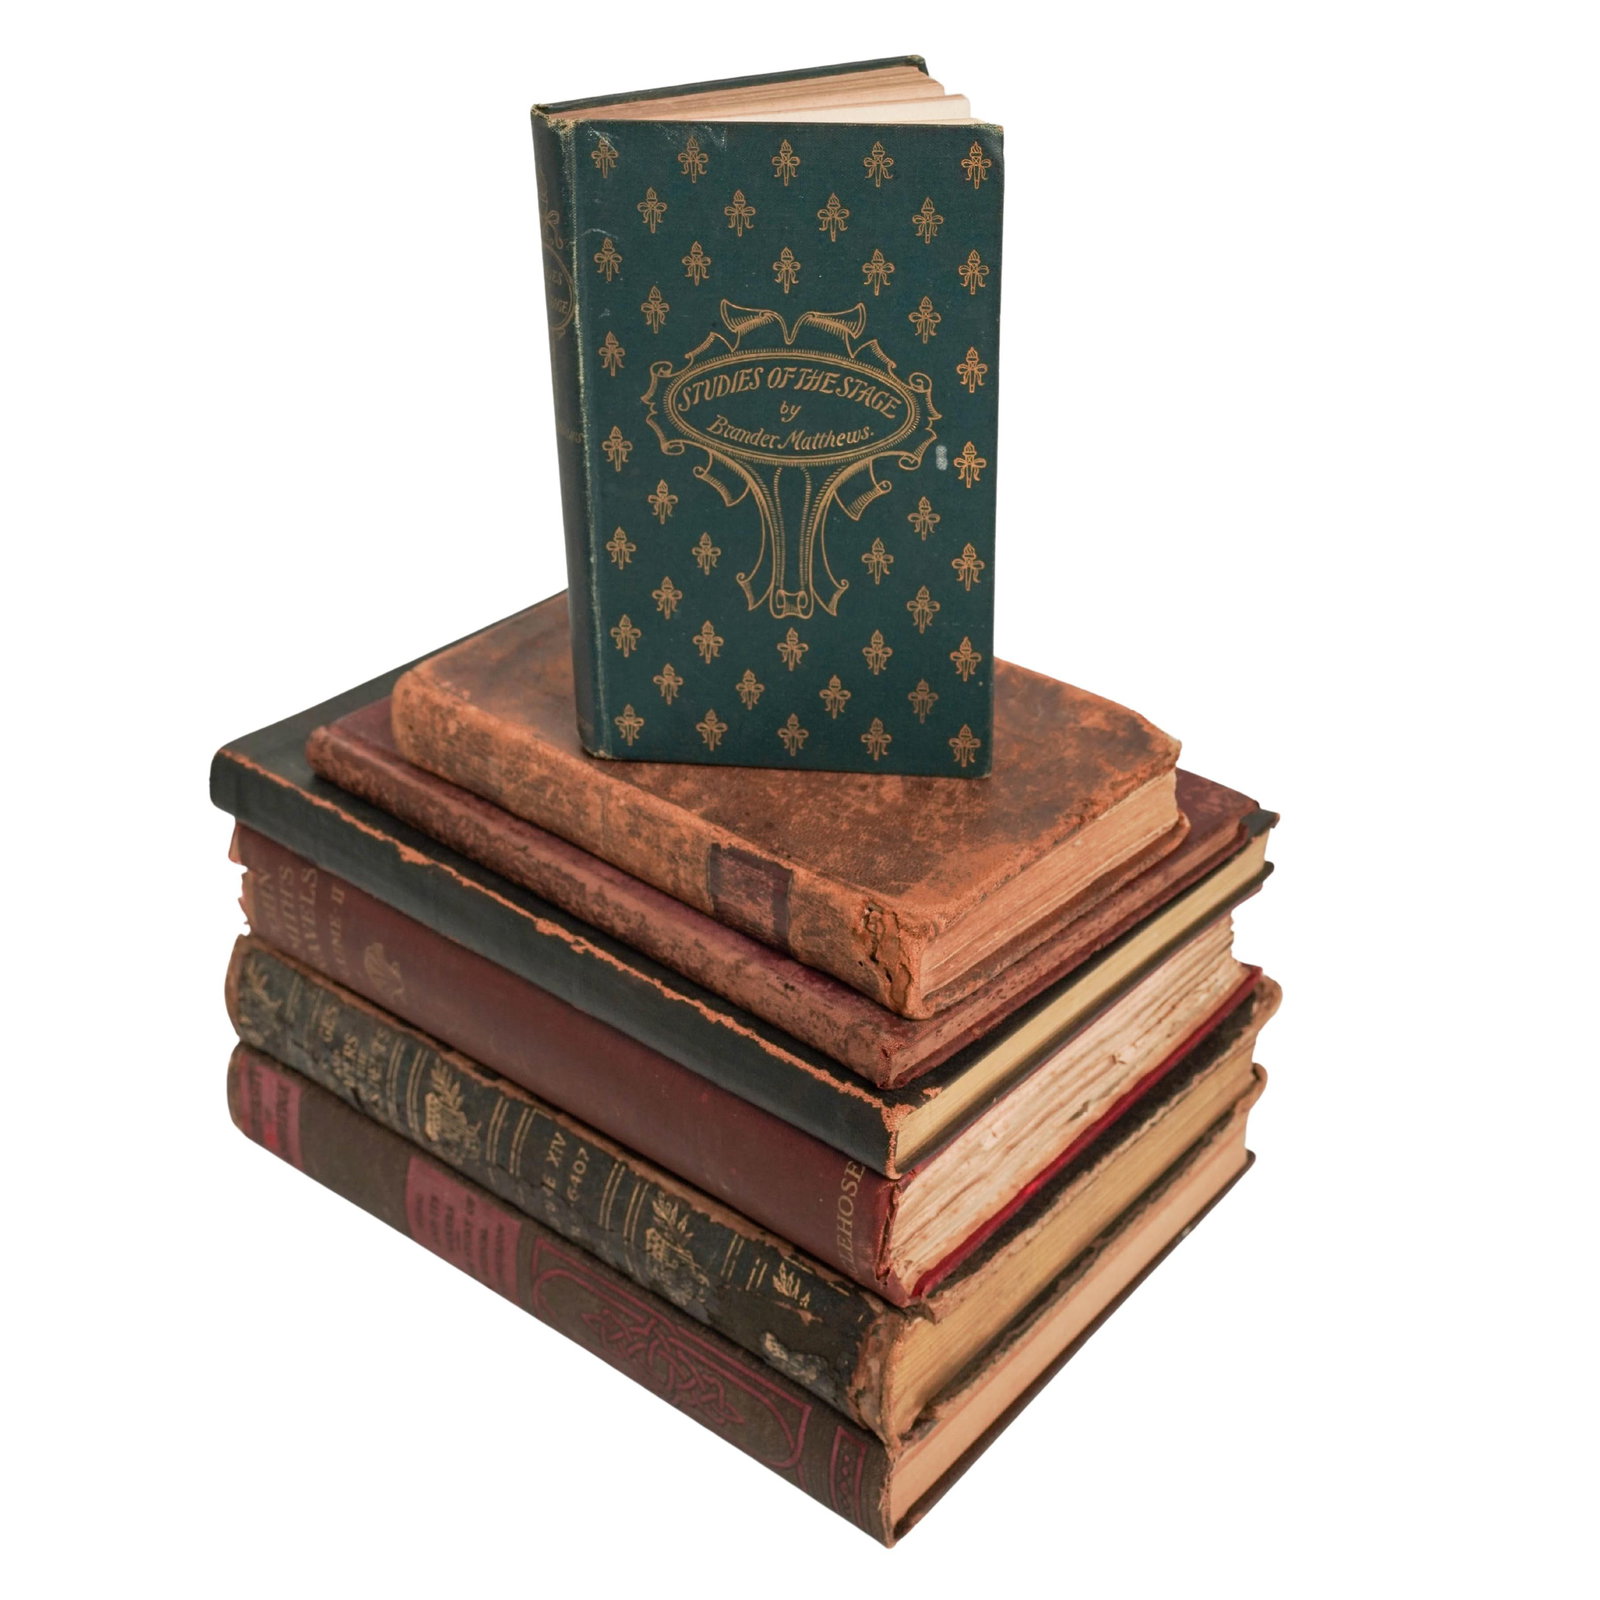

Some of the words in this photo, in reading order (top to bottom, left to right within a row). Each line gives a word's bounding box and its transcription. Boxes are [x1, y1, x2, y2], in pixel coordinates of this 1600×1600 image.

[677, 366, 764, 412] STUDIES
[767, 366, 794, 389] OF
[796, 367, 838, 394] THE
[835, 376, 902, 419] STAGE
[779, 401, 802, 423] by
[705, 414, 780, 449] Brander
[777, 424, 875, 450] Matthews.
